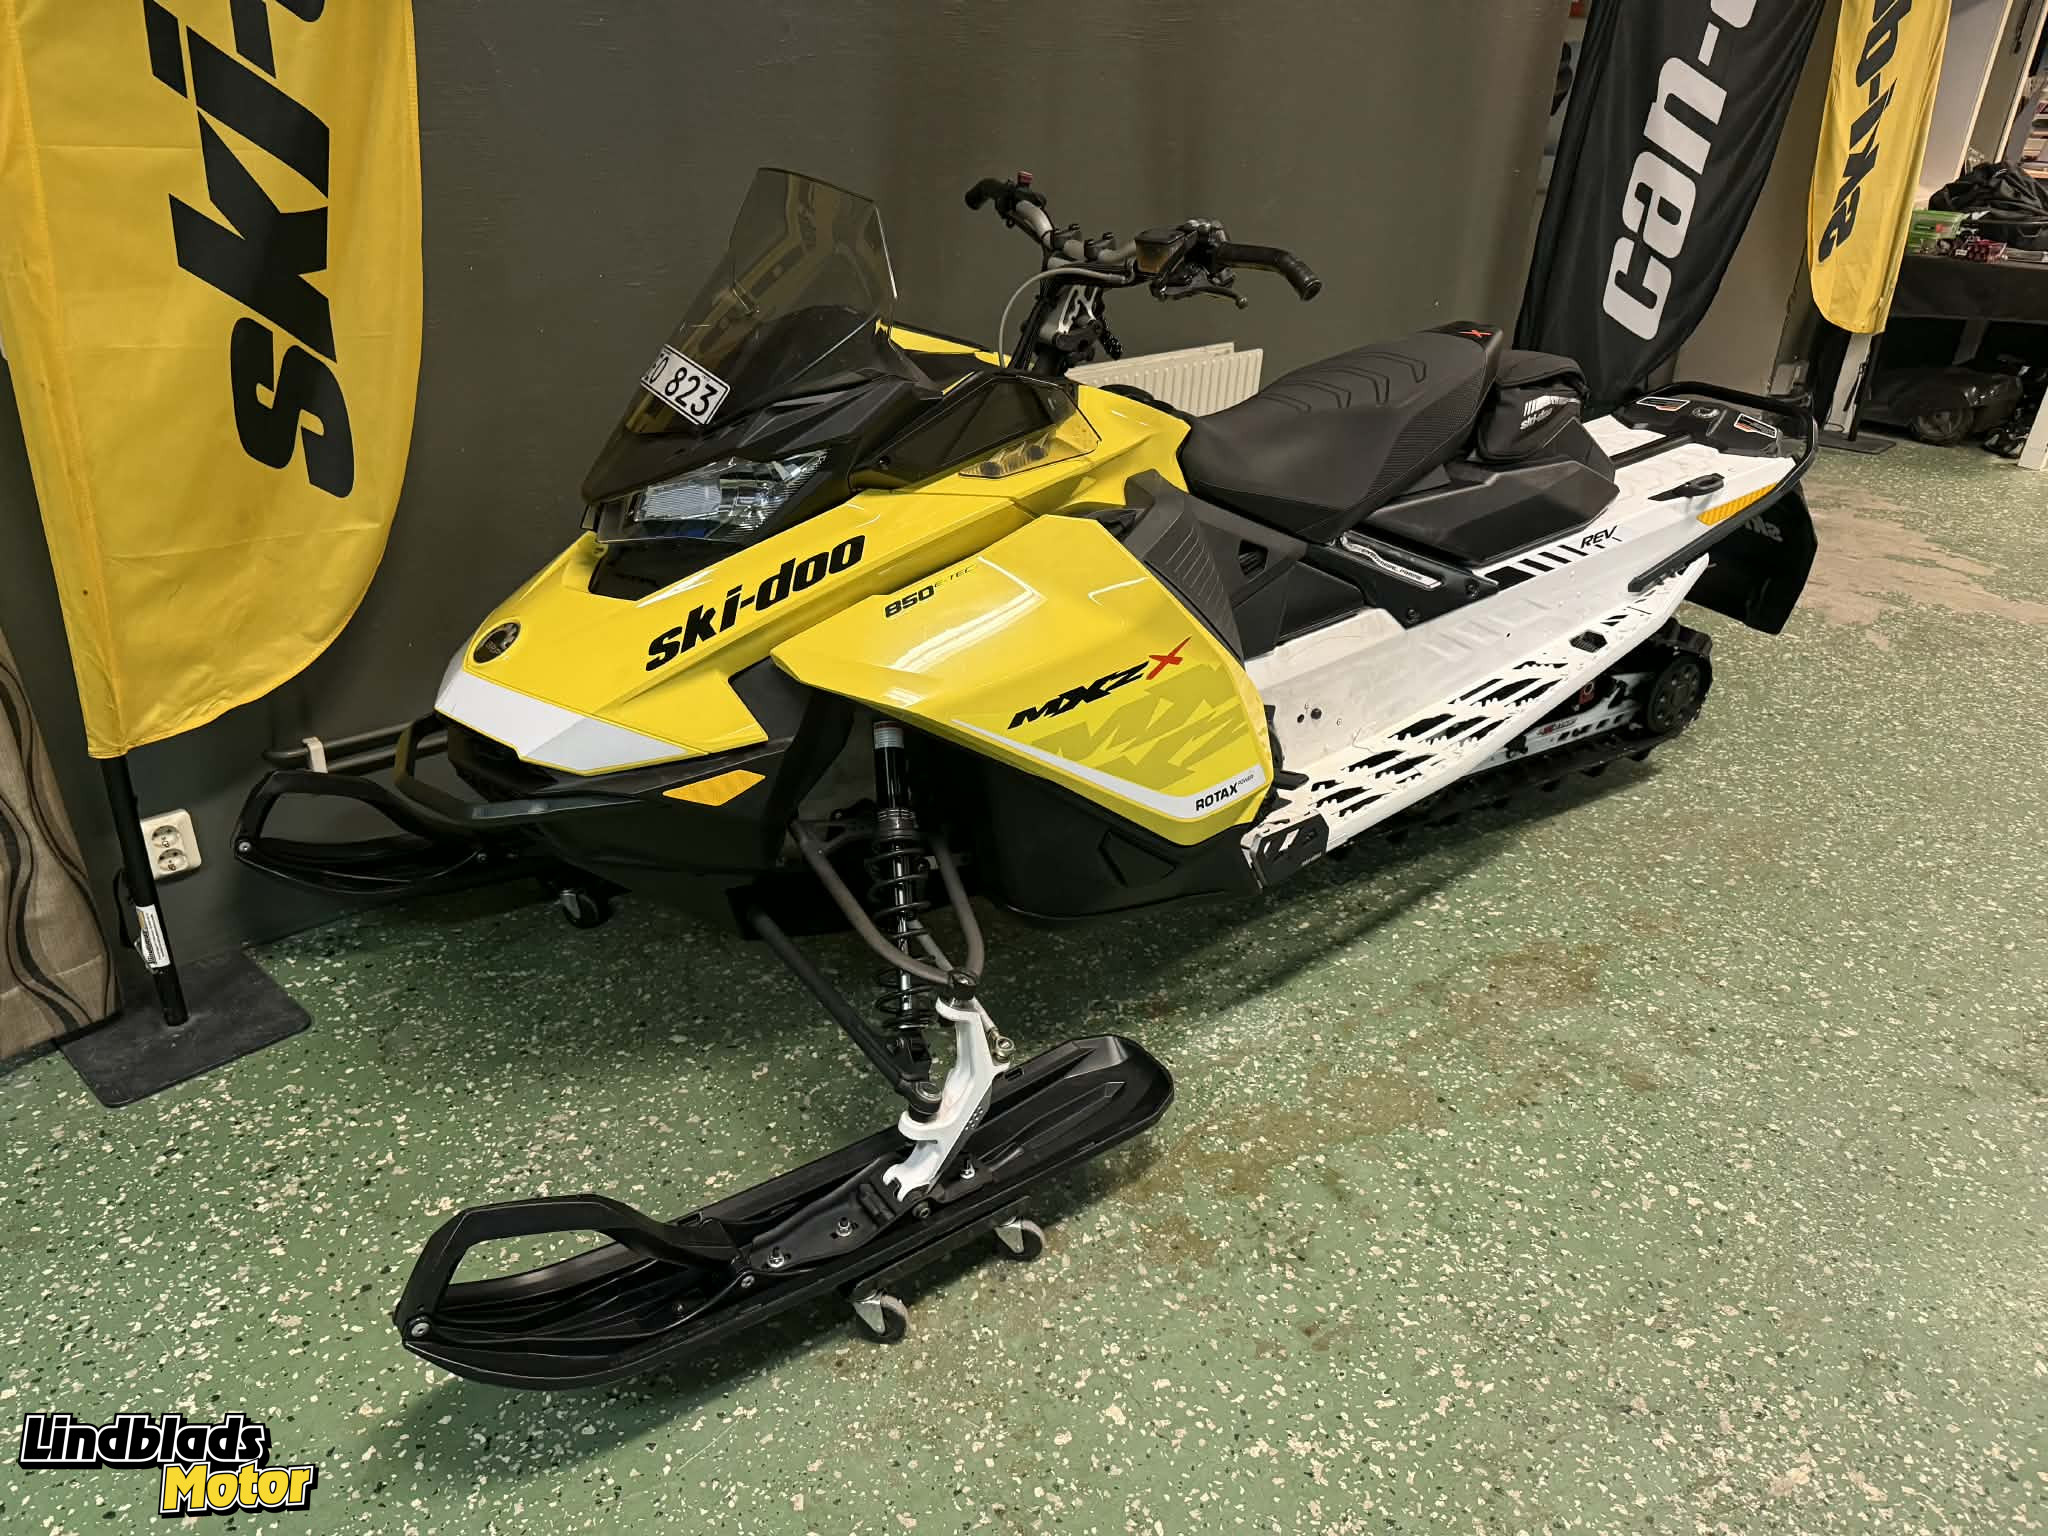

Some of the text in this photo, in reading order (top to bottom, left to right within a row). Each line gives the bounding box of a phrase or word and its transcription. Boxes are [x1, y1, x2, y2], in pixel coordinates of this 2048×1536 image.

[1602, 0, 1756, 340] can-
[142, 0, 354, 498] ski-
[665, 367, 718, 416] 823
[1580, 525, 1618, 549] REV
[645, 534, 866, 671] ski-doo
[885, 585, 935, 618] 850
[1196, 782, 1238, 811] ROTAX
